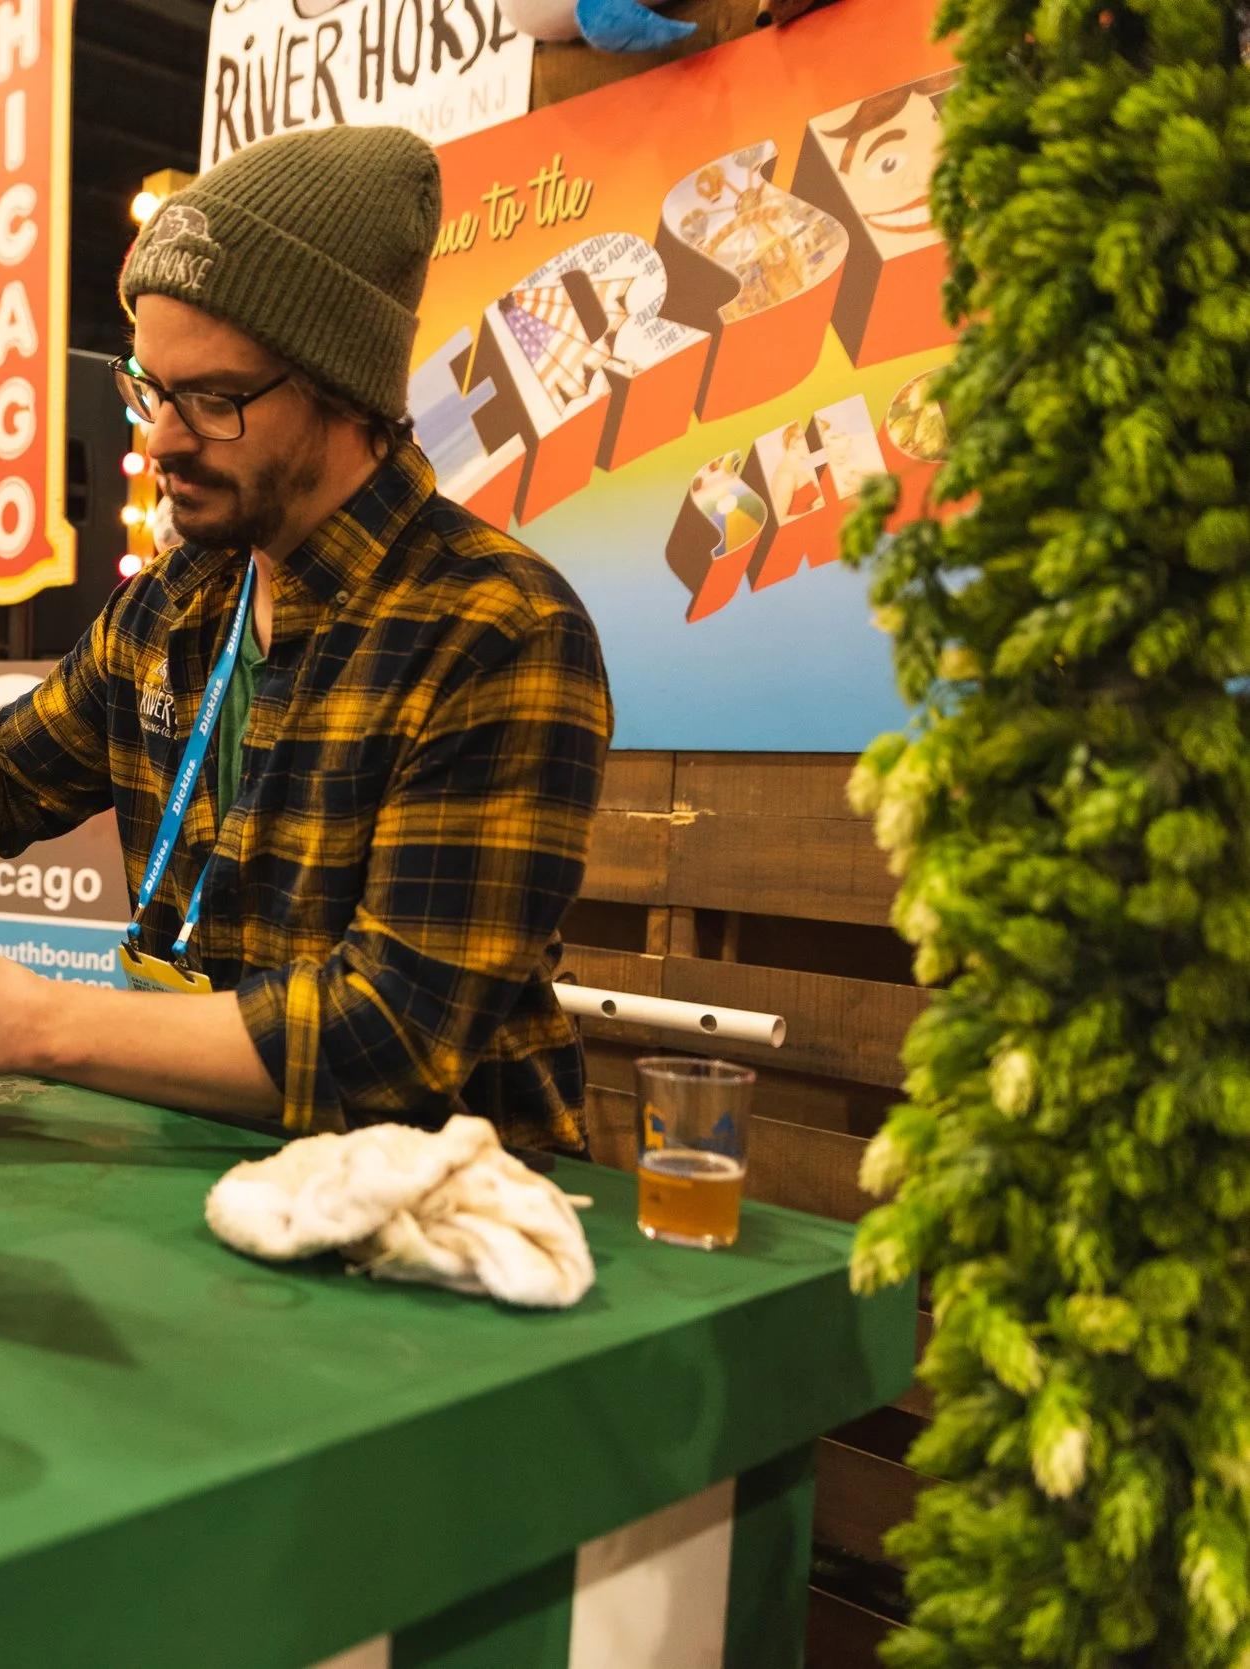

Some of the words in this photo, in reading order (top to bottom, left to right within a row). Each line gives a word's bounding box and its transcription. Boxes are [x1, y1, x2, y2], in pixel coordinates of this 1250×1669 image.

[469, 73, 507, 122] NJ
[481, 181, 527, 240] to
[527, 152, 593, 227] the
[226, 598, 245, 656] Dickies
[199, 678, 223, 737] Dickies
[171, 759, 197, 817] Dickies
[143, 839, 170, 894] Dickies
